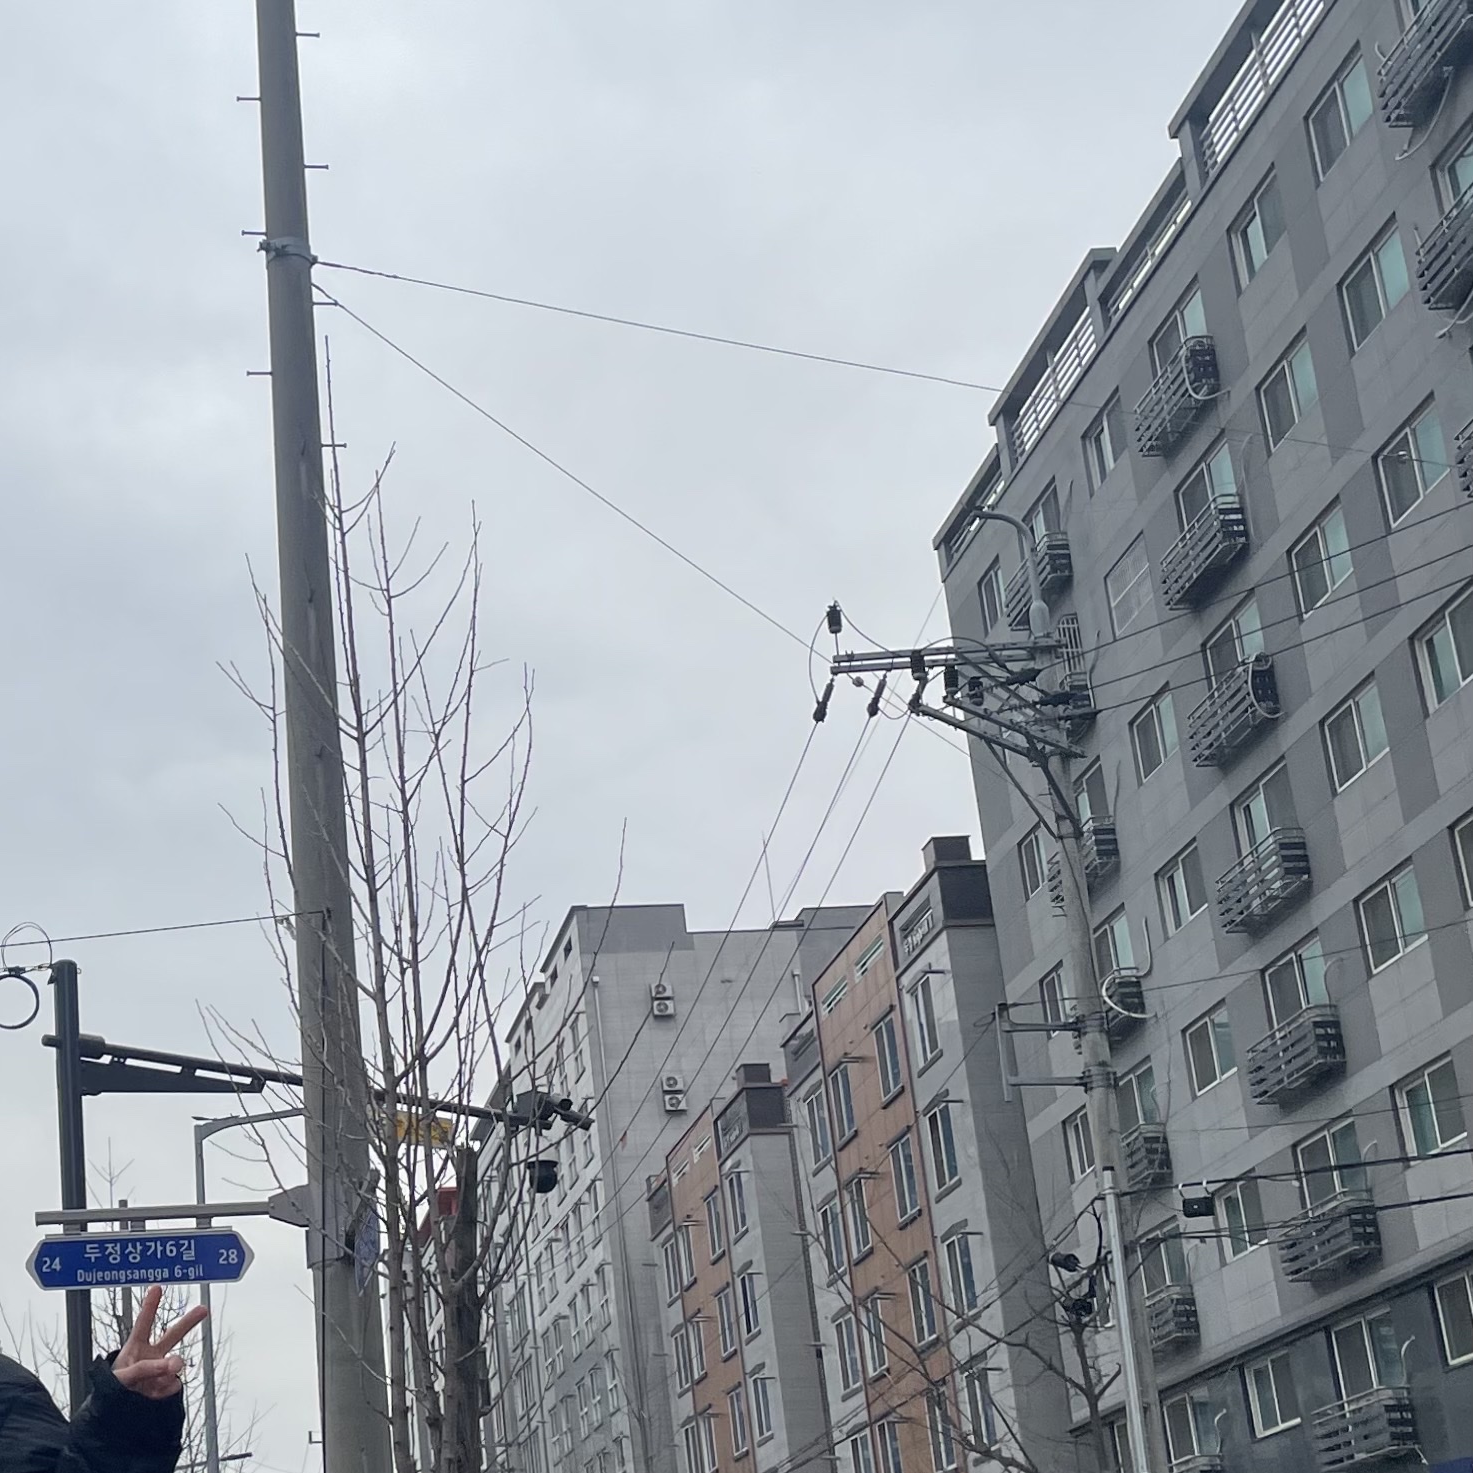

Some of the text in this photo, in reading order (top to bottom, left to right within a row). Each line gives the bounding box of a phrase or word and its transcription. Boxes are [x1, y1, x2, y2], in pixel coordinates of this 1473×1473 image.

[84, 1239, 196, 1263] 두정상가6길
[218, 1249, 238, 1264] 28
[42, 1257, 61, 1272] 24
[77, 1264, 203, 1283] Dujeongsangga 6-gil
